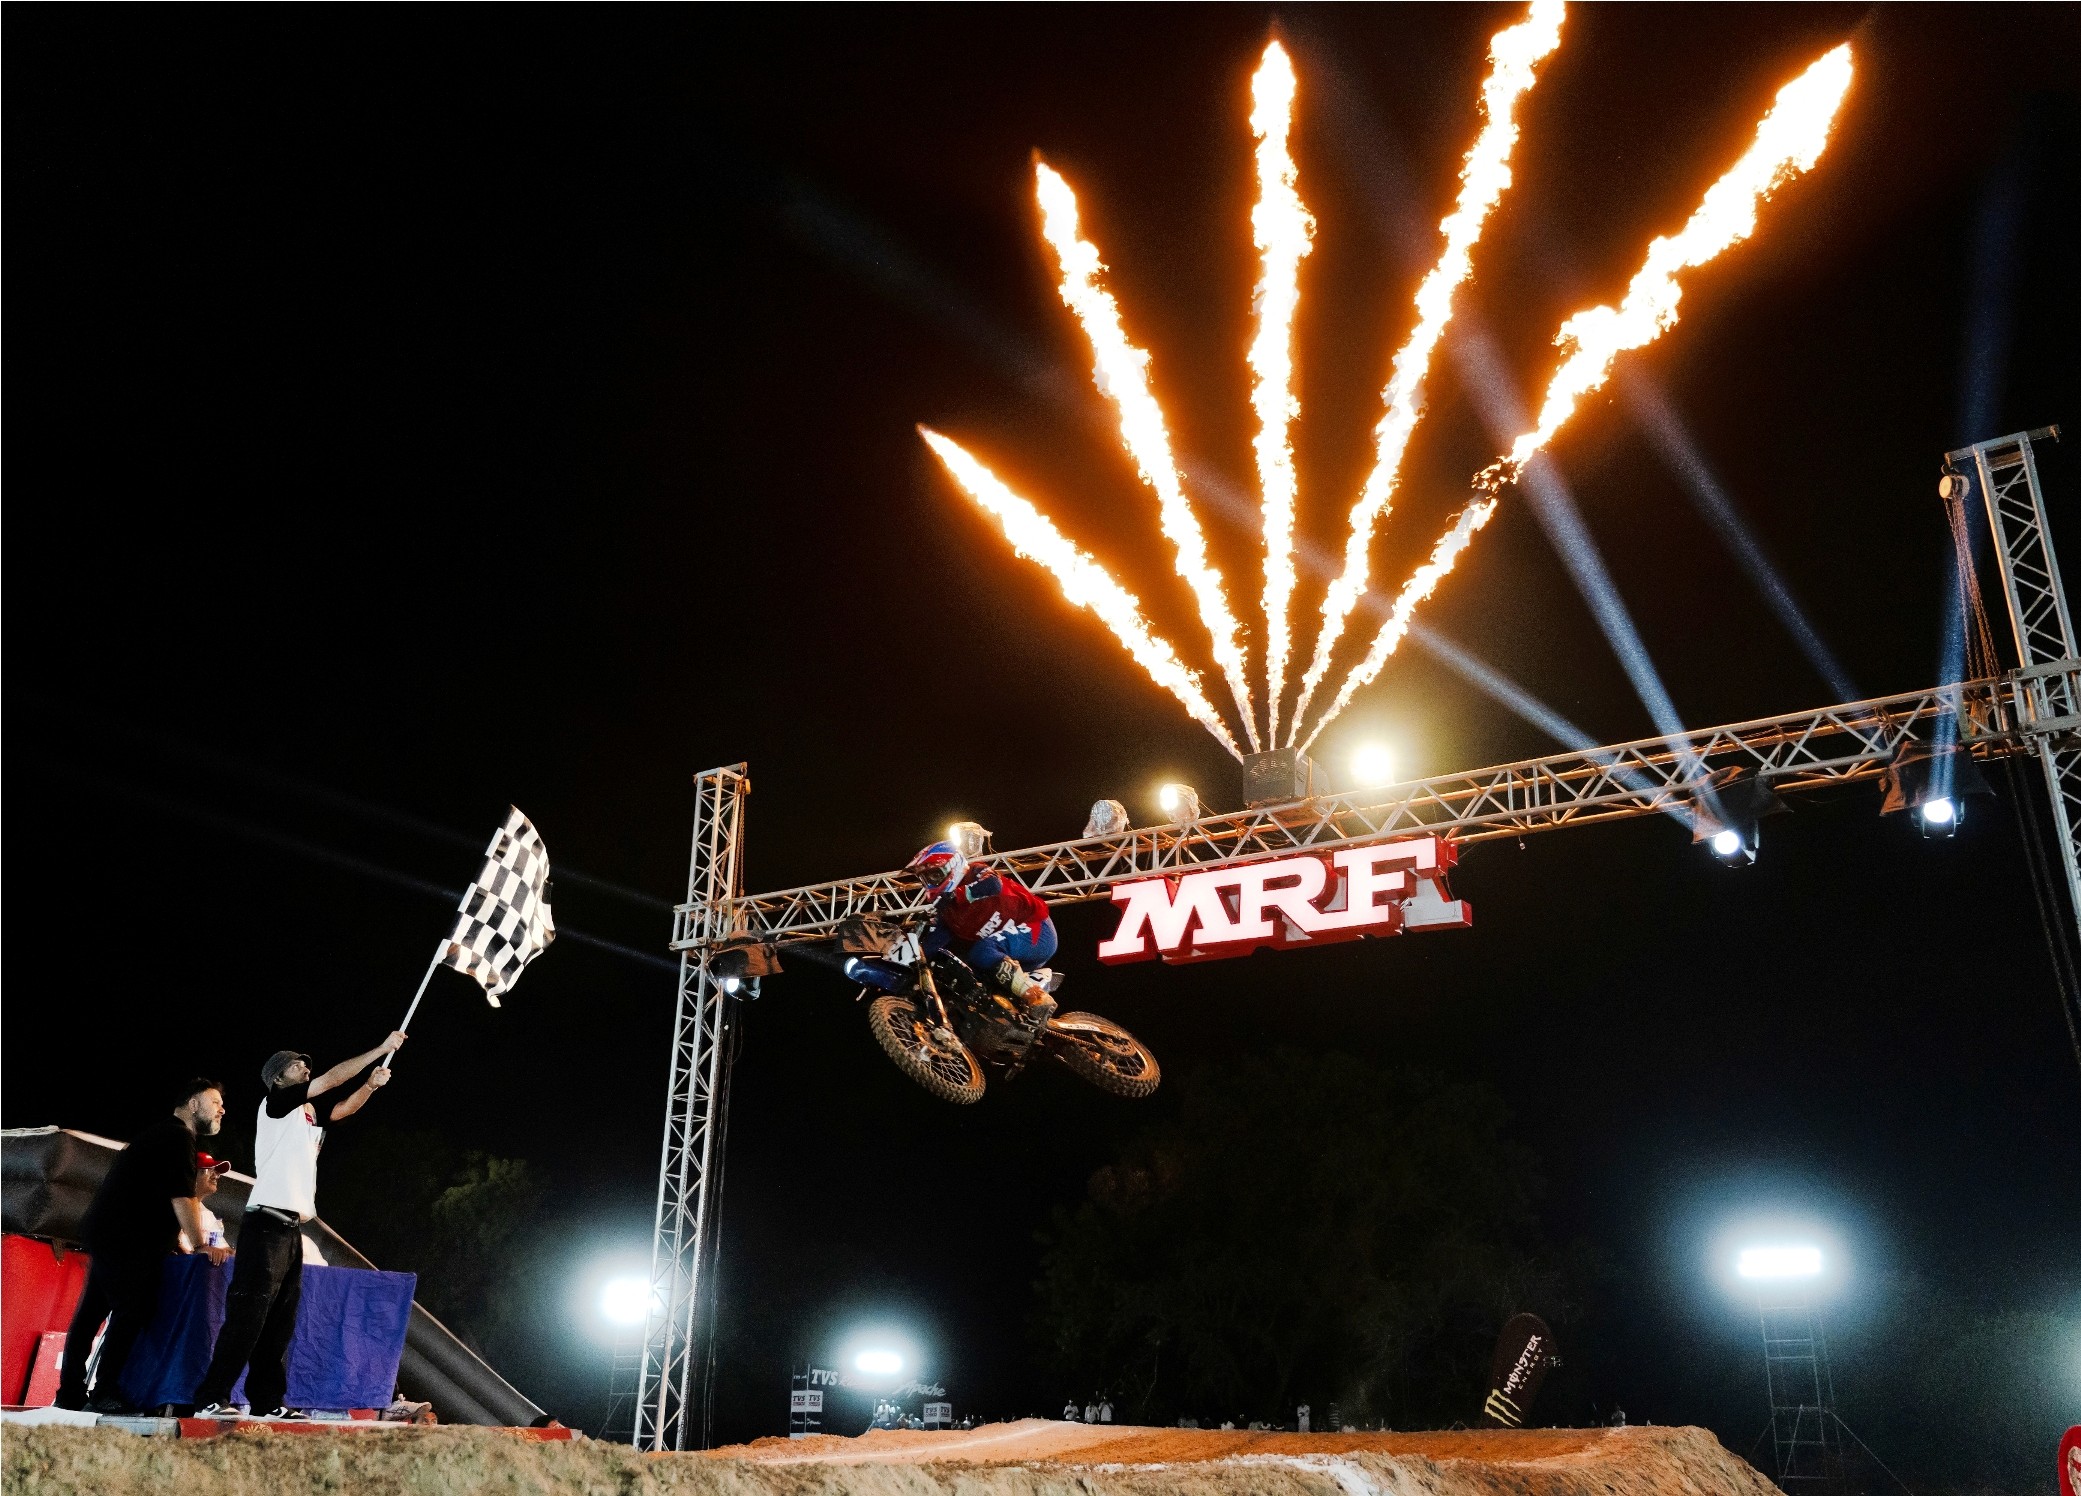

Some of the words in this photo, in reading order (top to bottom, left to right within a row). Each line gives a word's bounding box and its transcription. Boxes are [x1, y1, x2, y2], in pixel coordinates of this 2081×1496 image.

[1098, 838, 1437, 957] MRF
[976, 910, 1002, 939] MRF
[811, 1369, 839, 1386] TVS
[1503, 1335, 1542, 1394] MONSTER
[1518, 1347, 1543, 1390] ENERGY
[808, 1394, 820, 1402] TVS
[892, 1380, 947, 1398] Apache
